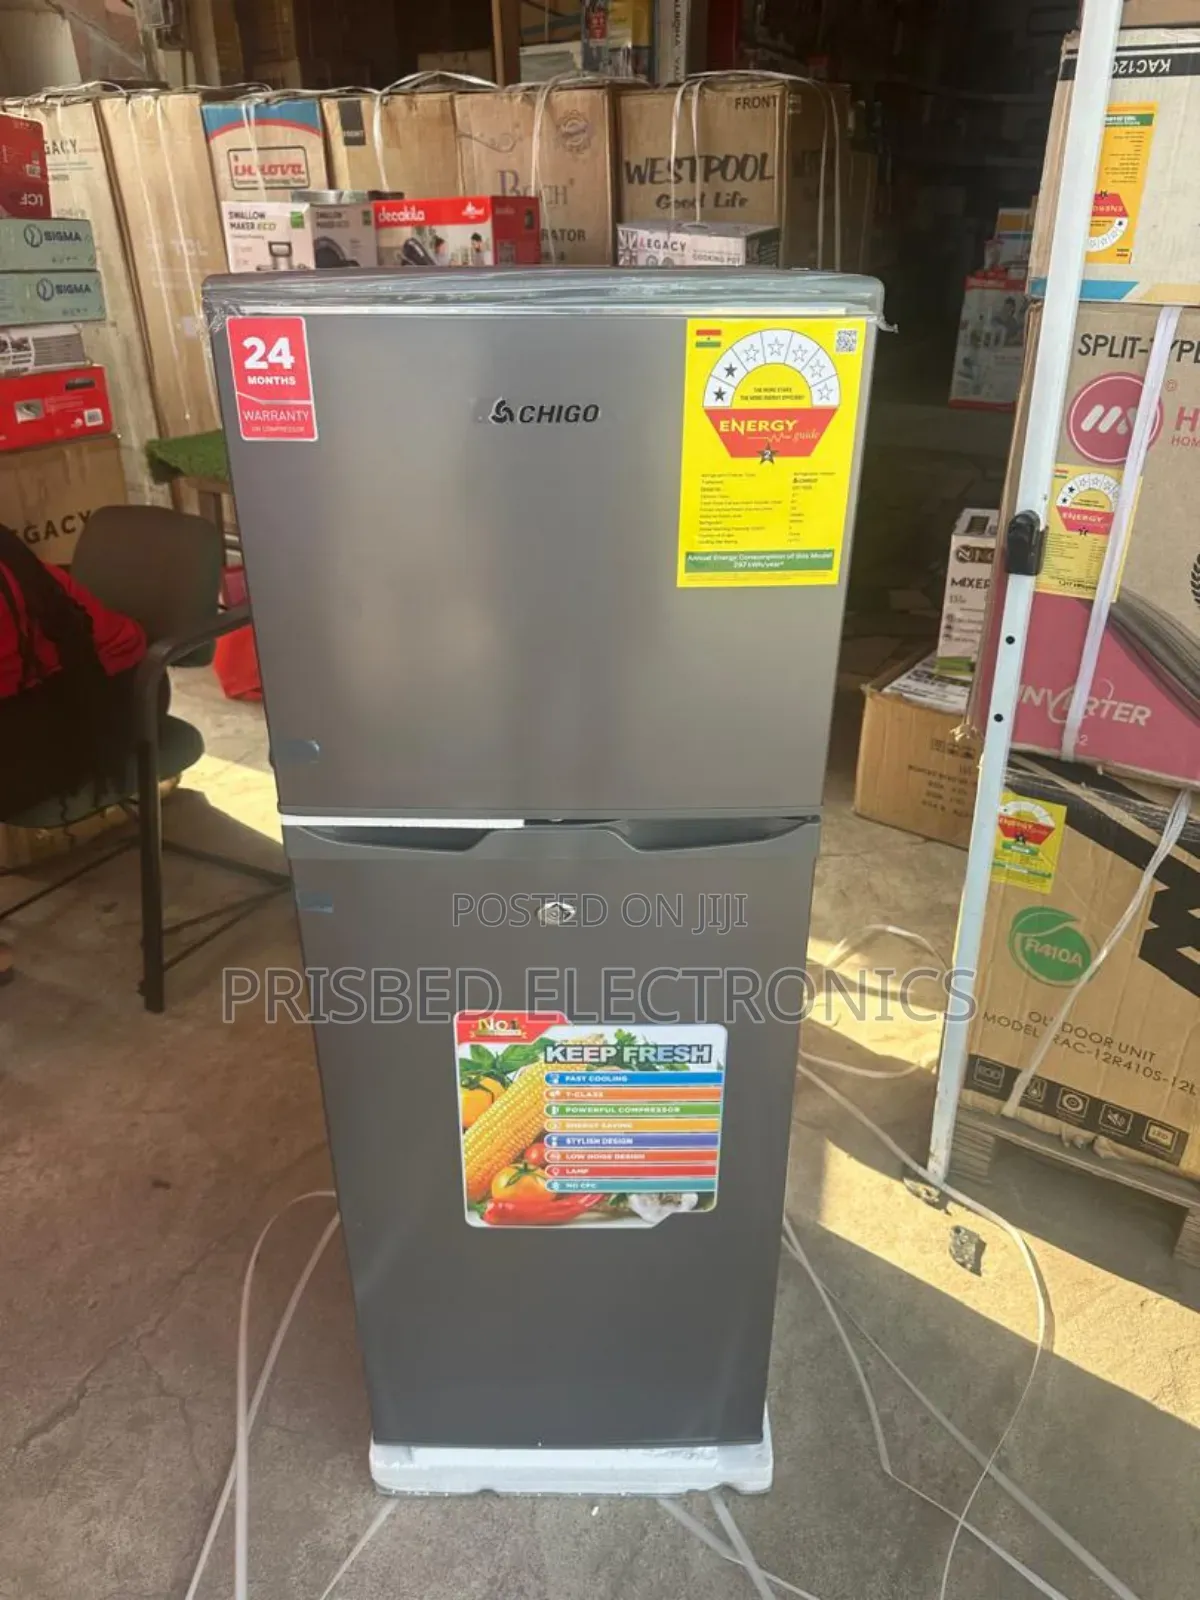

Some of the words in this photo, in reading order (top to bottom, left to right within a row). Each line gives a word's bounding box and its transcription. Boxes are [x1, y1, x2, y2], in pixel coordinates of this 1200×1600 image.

[735, 95, 777, 110] FRONT
[625, 152, 775, 186] WESTPOOL
[714, 190, 748, 209] Life
[43, 231, 82, 242] SIGMA
[640, 237, 687, 252] LEGACY
[55, 284, 92, 295] SIGMA
[242, 336, 296, 369] 24
[247, 375, 297, 385] MONTHS
[242, 410, 309, 422] WARRANTY
[519, 404, 600, 423] CHIGO
[719, 418, 797, 436] ENERGY
[11, 510, 91, 545] GACY
[1018, 682, 1152, 726] NVRTER
[1025, 937, 1083, 968] R410A
[982, 1011, 1040, 1039] MODEL
[1028, 1011, 1114, 1048] OUDOOR
[1118, 1042, 1156, 1064] UNIT
[545, 1044, 617, 1065] KEEP
[622, 1044, 712, 1065] FRESH
[565, 1137, 600, 1145] STYLISH
[602, 1137, 634, 1145] DESIGN
